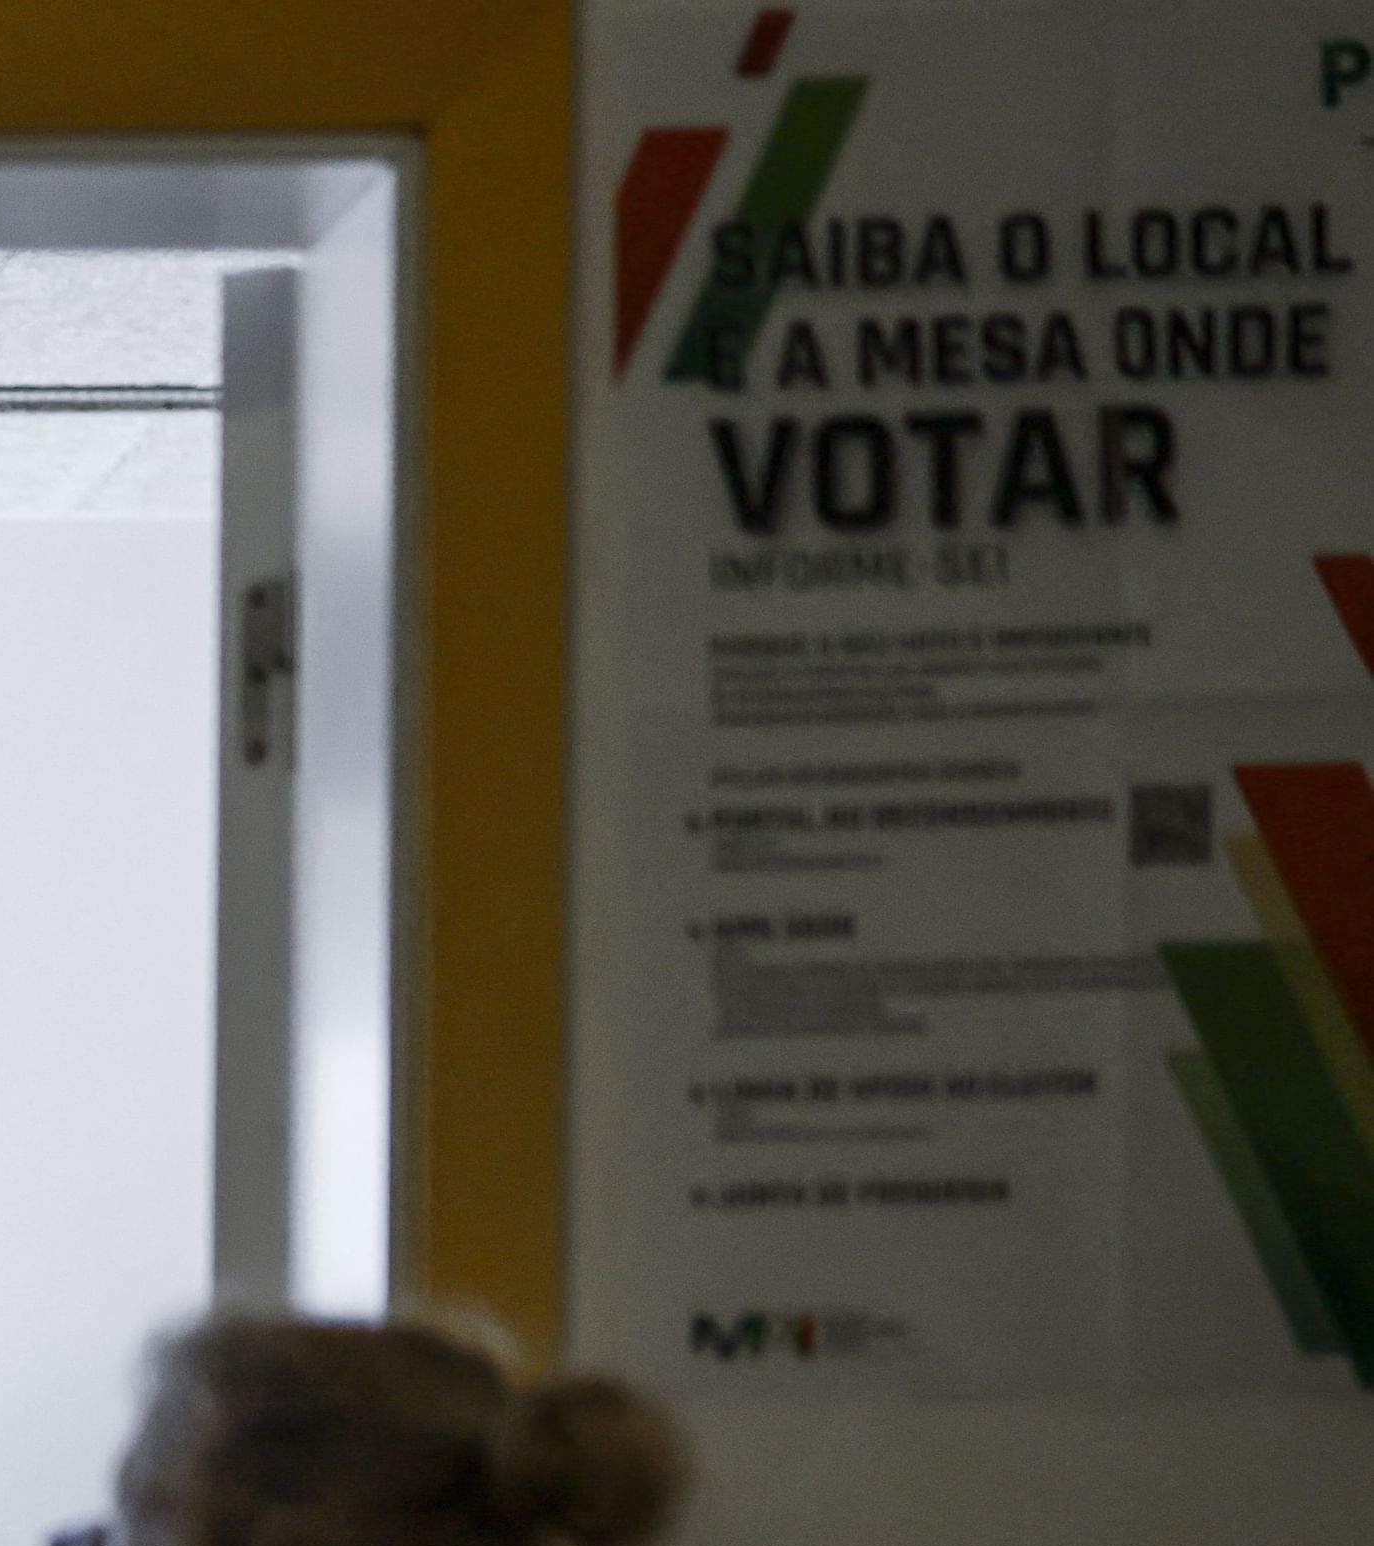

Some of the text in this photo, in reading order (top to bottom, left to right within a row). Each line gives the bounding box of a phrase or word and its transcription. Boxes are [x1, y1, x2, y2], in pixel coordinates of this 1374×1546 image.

[711, 201, 1357, 290] SAIBA O LOCAL
[708, 302, 1332, 392] E A MESA ONDE
[708, 404, 1181, 534] VOTAR
